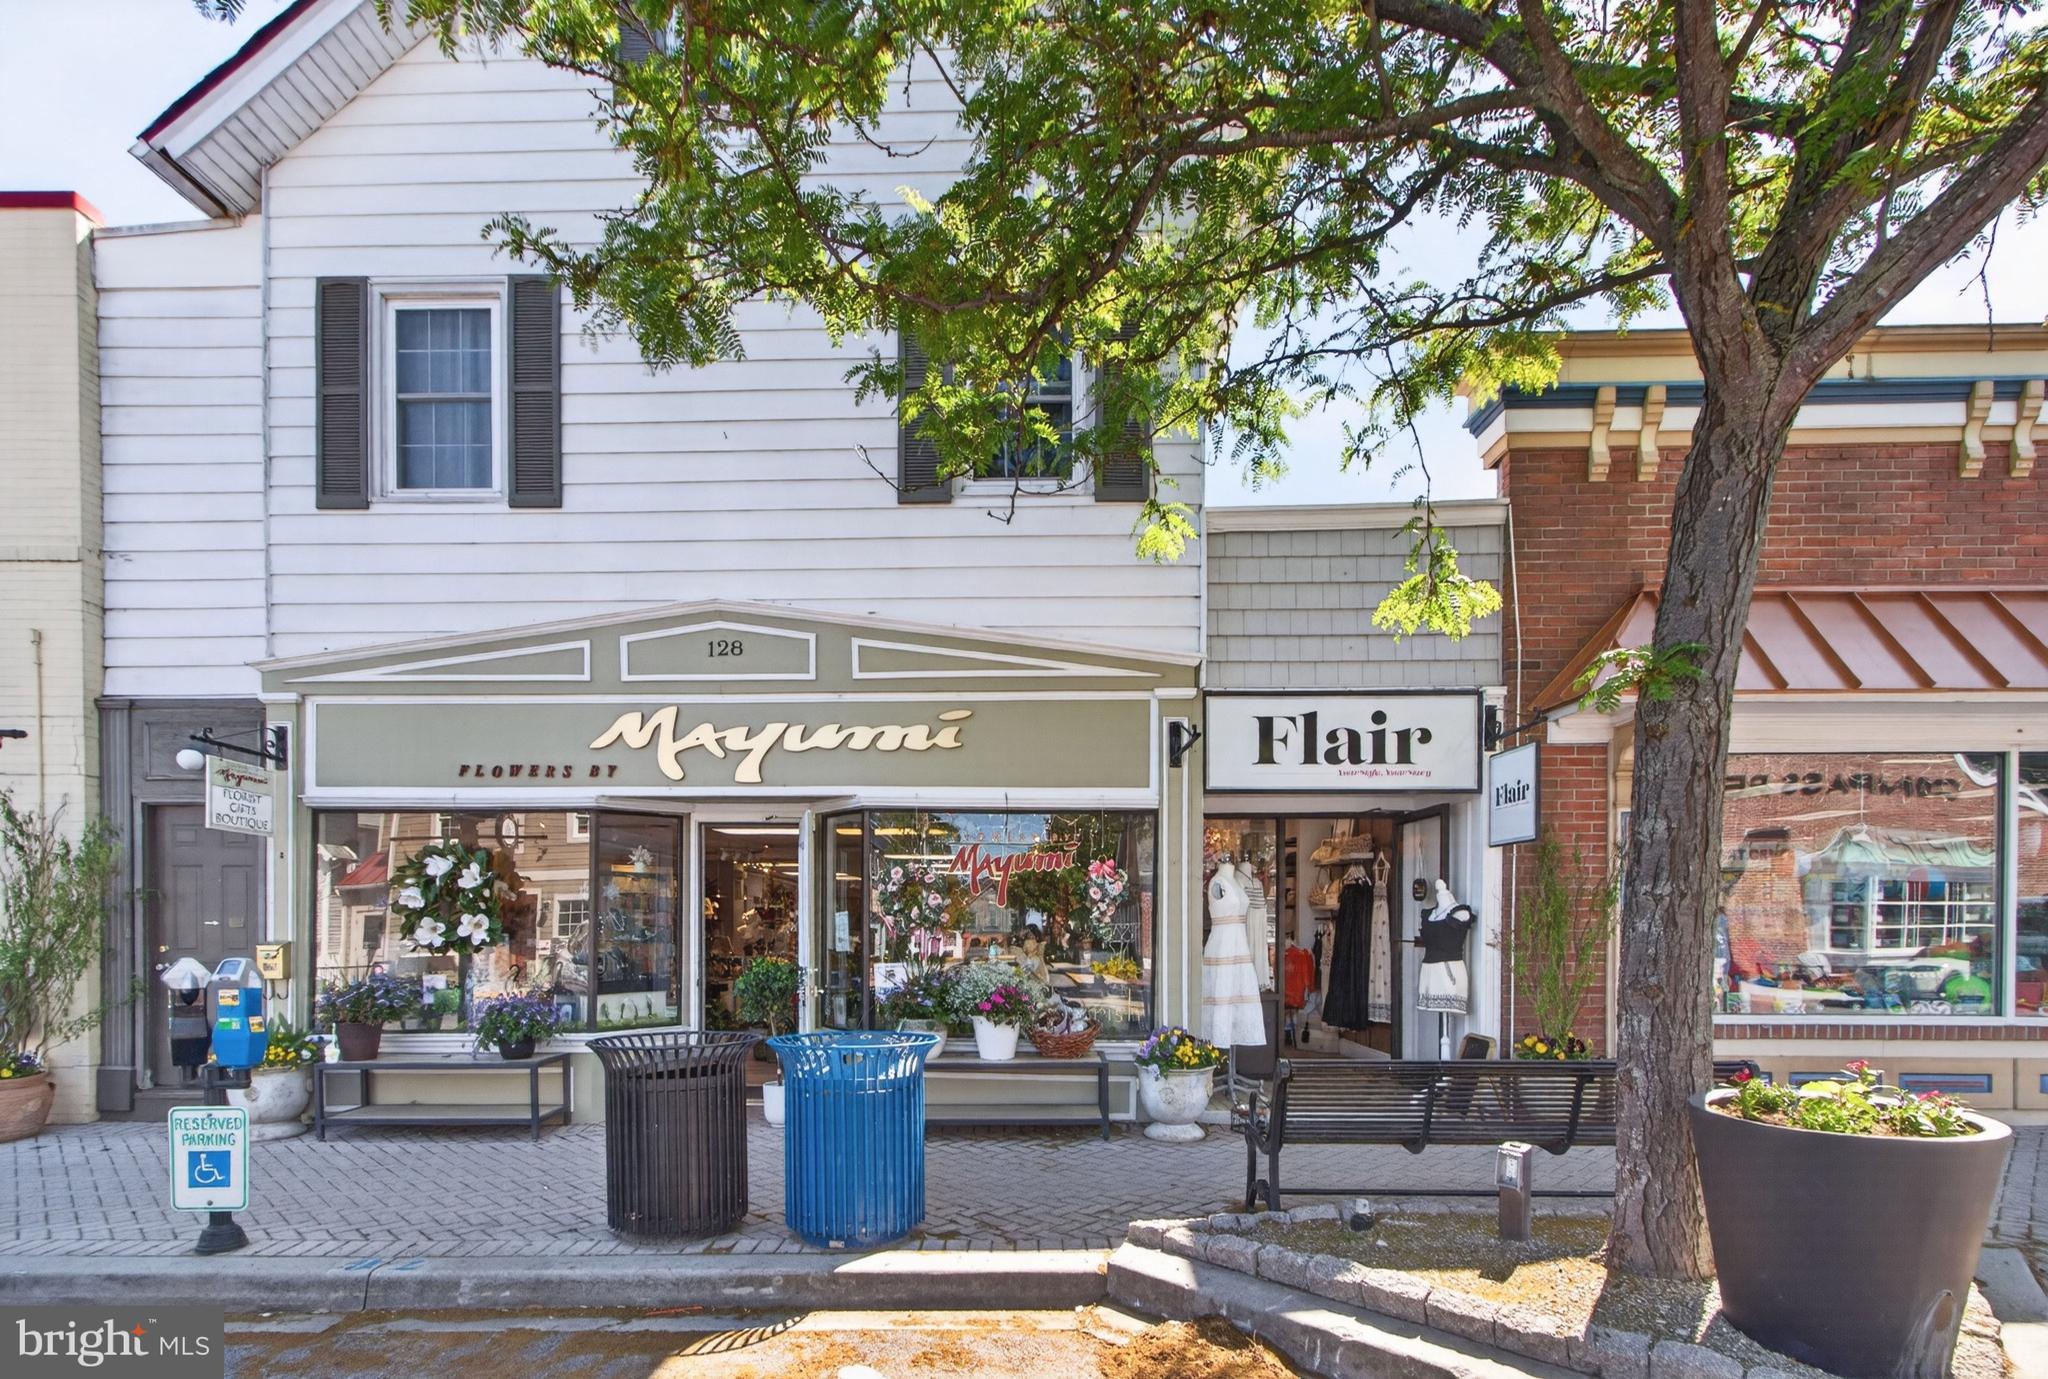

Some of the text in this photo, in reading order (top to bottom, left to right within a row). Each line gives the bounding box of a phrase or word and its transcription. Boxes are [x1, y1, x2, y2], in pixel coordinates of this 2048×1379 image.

[708, 639, 744, 658] 128
[458, 705, 974, 783] FLOWERS BY Mayumi
[1252, 709, 1433, 765] Flair
[1495, 779, 1530, 807] Flair
[215, 812, 269, 831] BOUTIQUE
[948, 840, 1081, 909] Mayumi
[174, 1116, 243, 1131] RESERVED
[181, 1132, 237, 1147] PARKING
